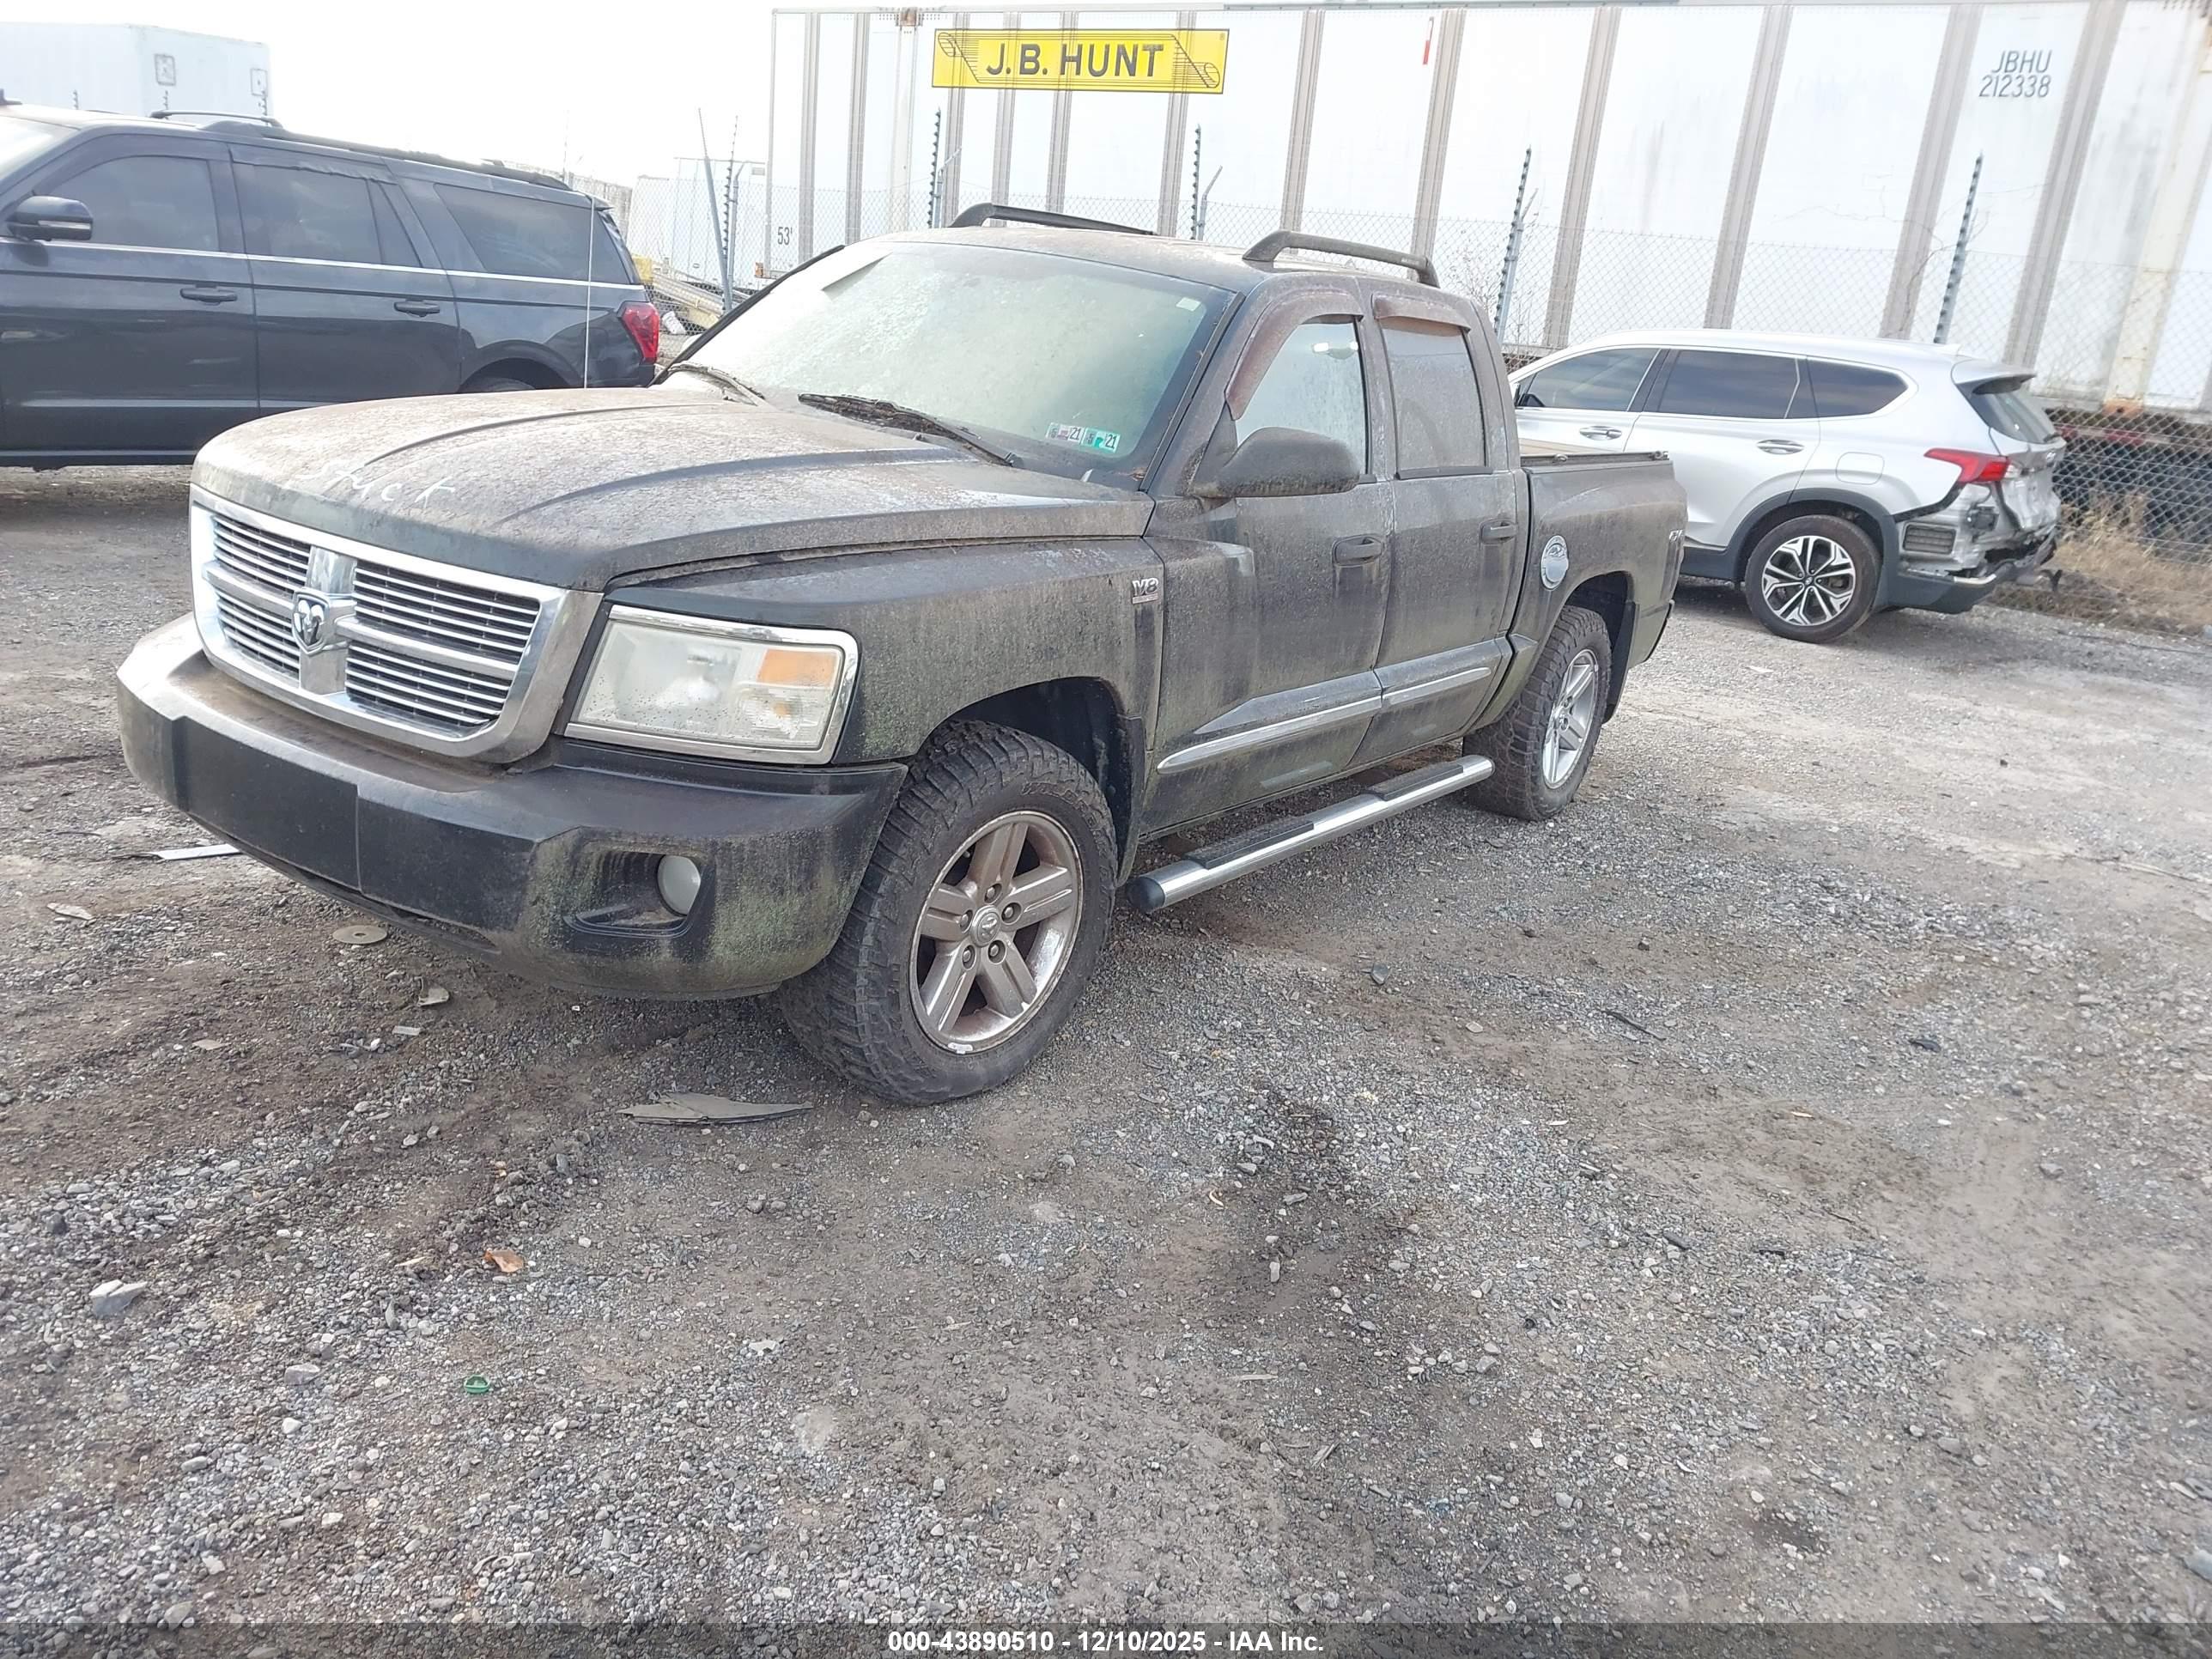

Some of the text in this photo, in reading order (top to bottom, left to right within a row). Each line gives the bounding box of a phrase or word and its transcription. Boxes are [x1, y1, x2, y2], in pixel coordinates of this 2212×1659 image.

[986, 43, 1164, 77] J.B. HUNT
[1991, 50, 2052, 73] JBHU
[1978, 75, 2051, 98] 212338
[1105, 433, 1117, 449] 21
